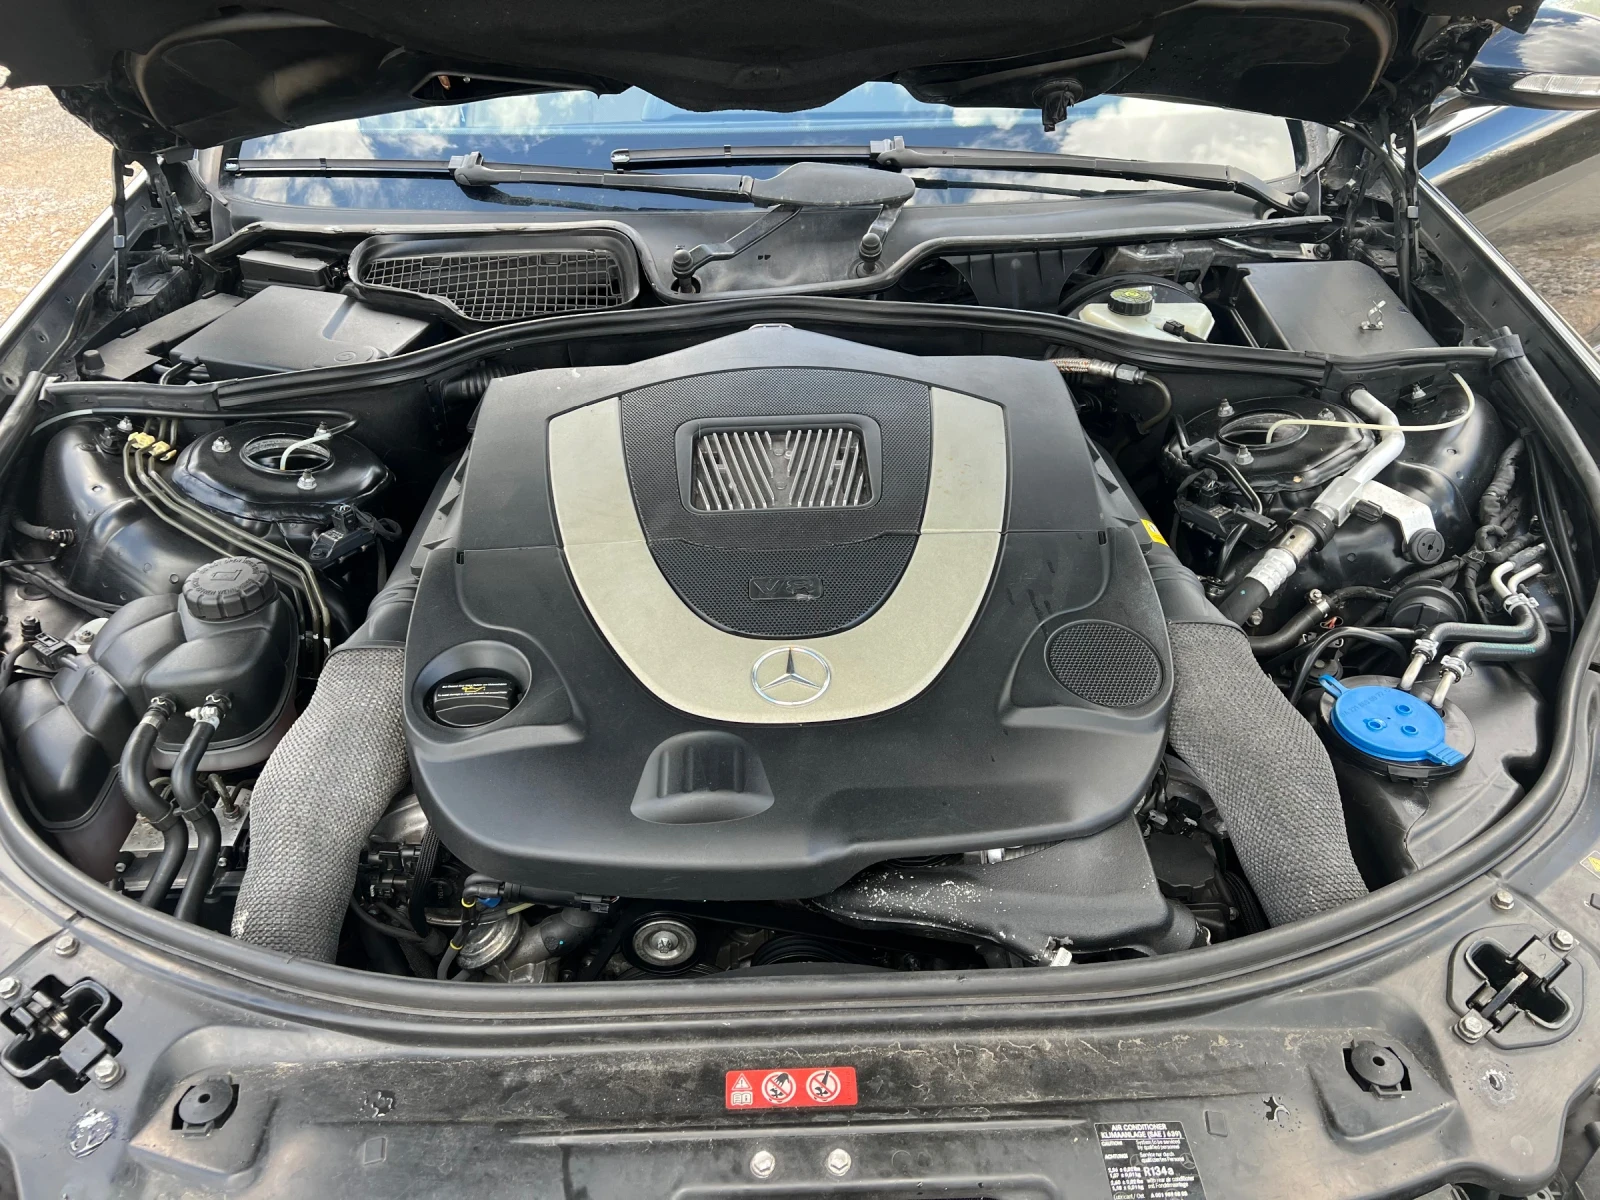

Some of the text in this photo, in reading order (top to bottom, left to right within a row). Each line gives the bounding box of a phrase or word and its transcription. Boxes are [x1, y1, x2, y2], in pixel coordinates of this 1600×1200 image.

[1111, 1123, 1168, 1132] AIR CONDITIONER
[1100, 1131, 1147, 1139] KLIMAANLAGE
[1143, 1166, 1175, 1177] R134a
